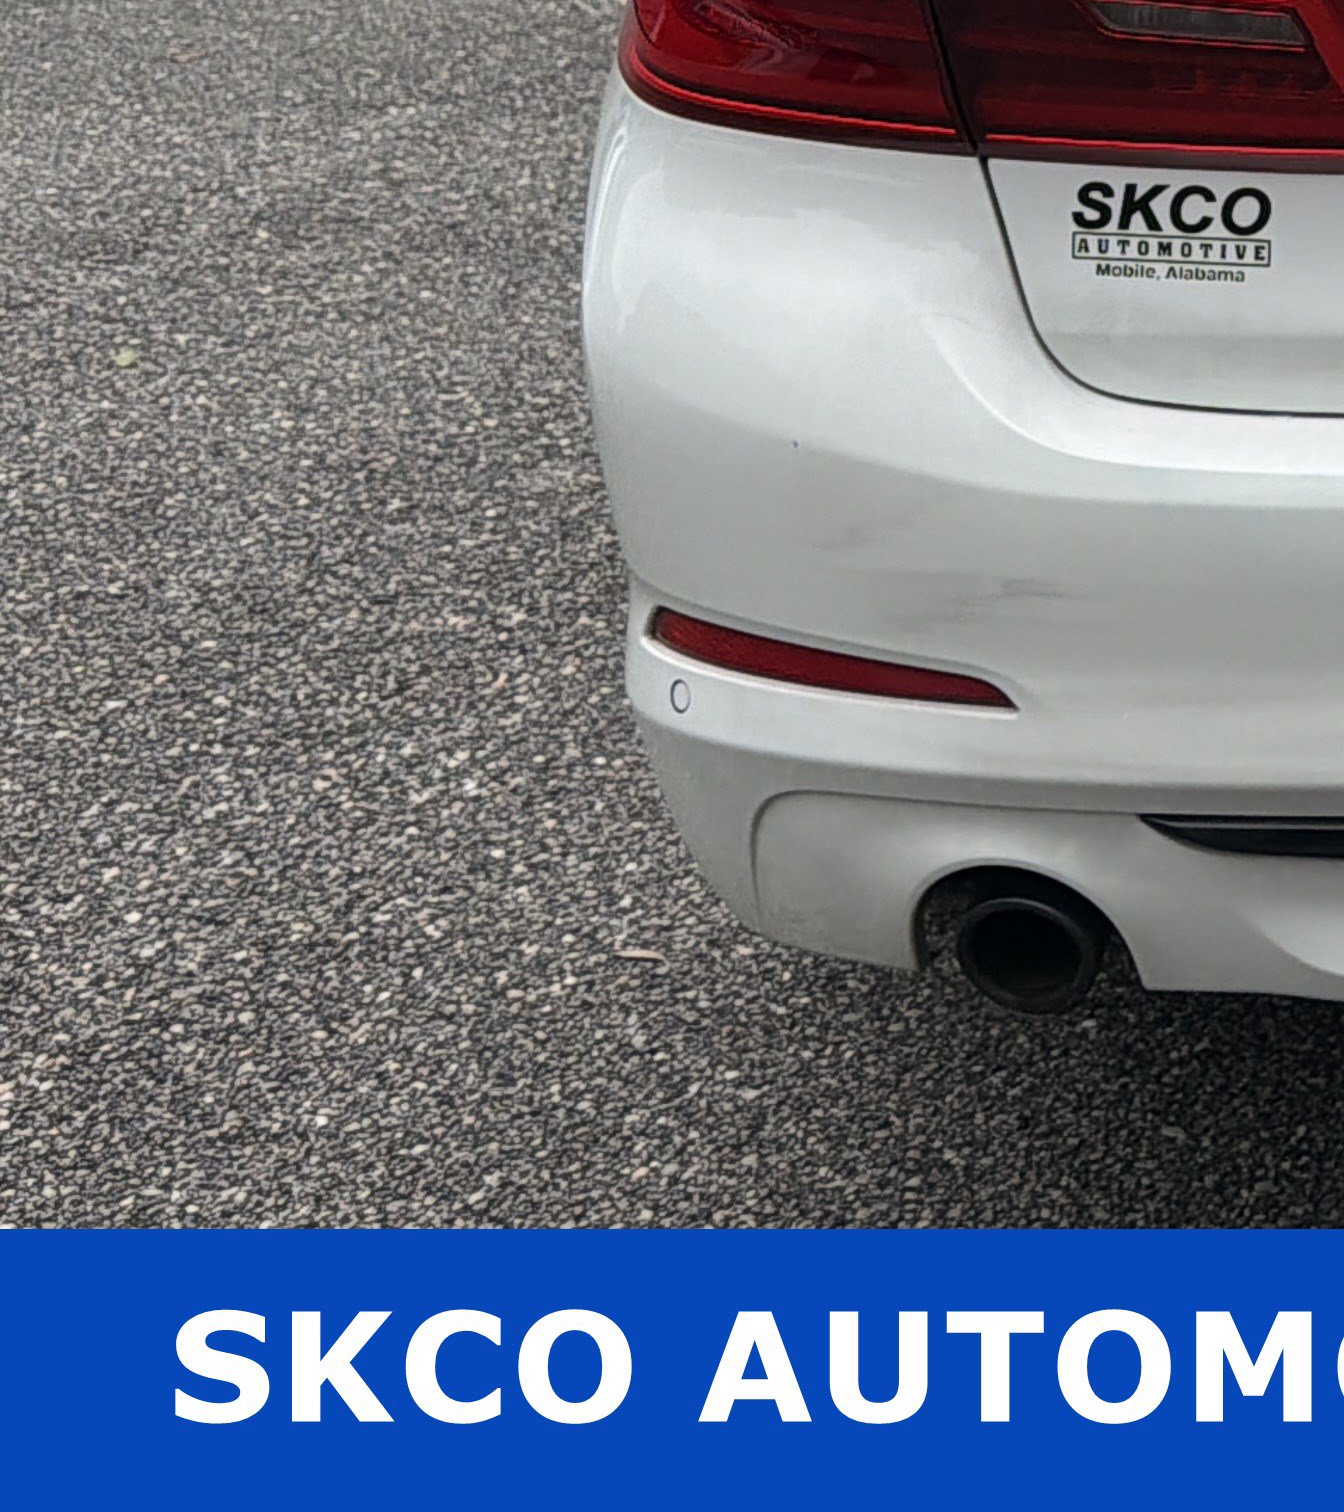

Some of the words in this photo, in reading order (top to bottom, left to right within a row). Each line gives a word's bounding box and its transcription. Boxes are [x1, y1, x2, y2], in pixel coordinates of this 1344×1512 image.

[1071, 181, 1272, 237] SKCO
[1077, 238, 1266, 261] AUTOMOTIVE
[1095, 262, 1161, 281] Mobile,
[1165, 265, 1245, 283] Alabama
